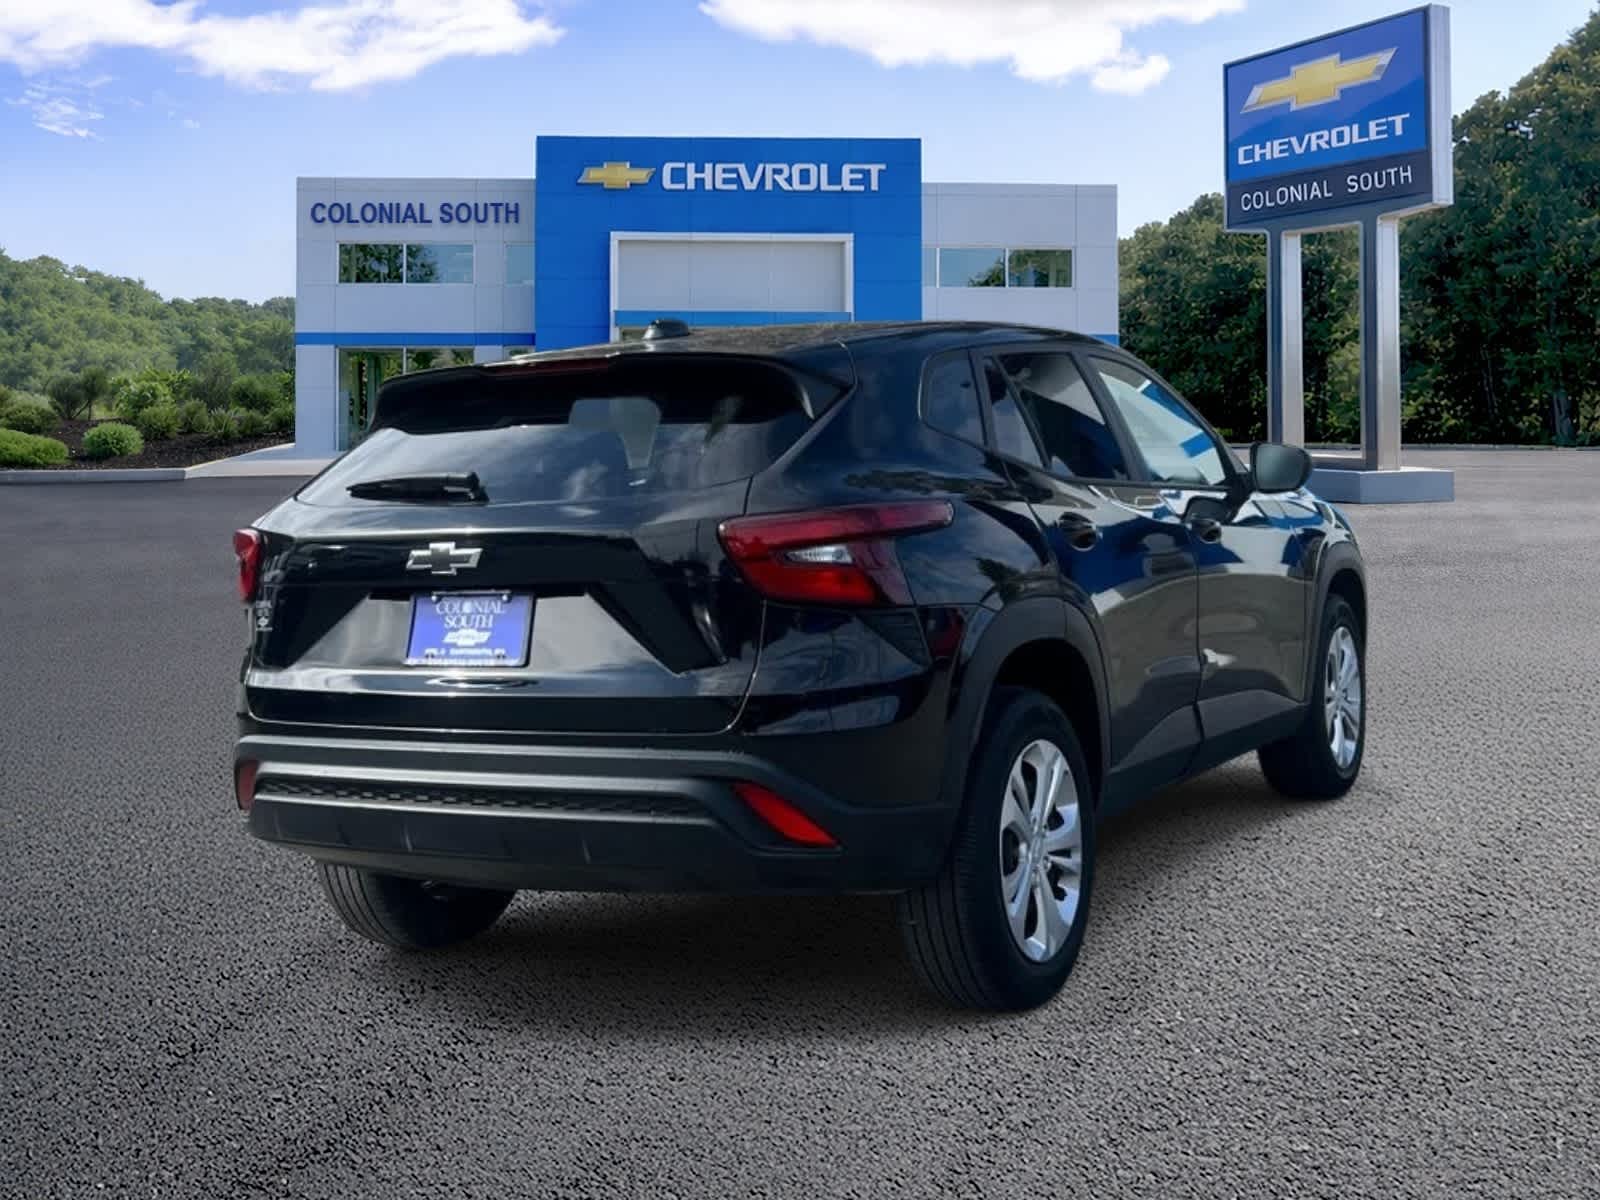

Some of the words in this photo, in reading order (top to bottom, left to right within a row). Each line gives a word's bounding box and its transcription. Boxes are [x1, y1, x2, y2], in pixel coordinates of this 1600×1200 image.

[1237, 115, 1410, 165] CHEVROLET
[662, 162, 886, 192] CHEVROLET
[1240, 181, 1333, 211] COLONIAL
[1346, 165, 1413, 193] SOUTH
[311, 203, 433, 224] COLONIAL
[439, 203, 520, 224] SOUTH
[444, 614, 494, 629] SOUTH
